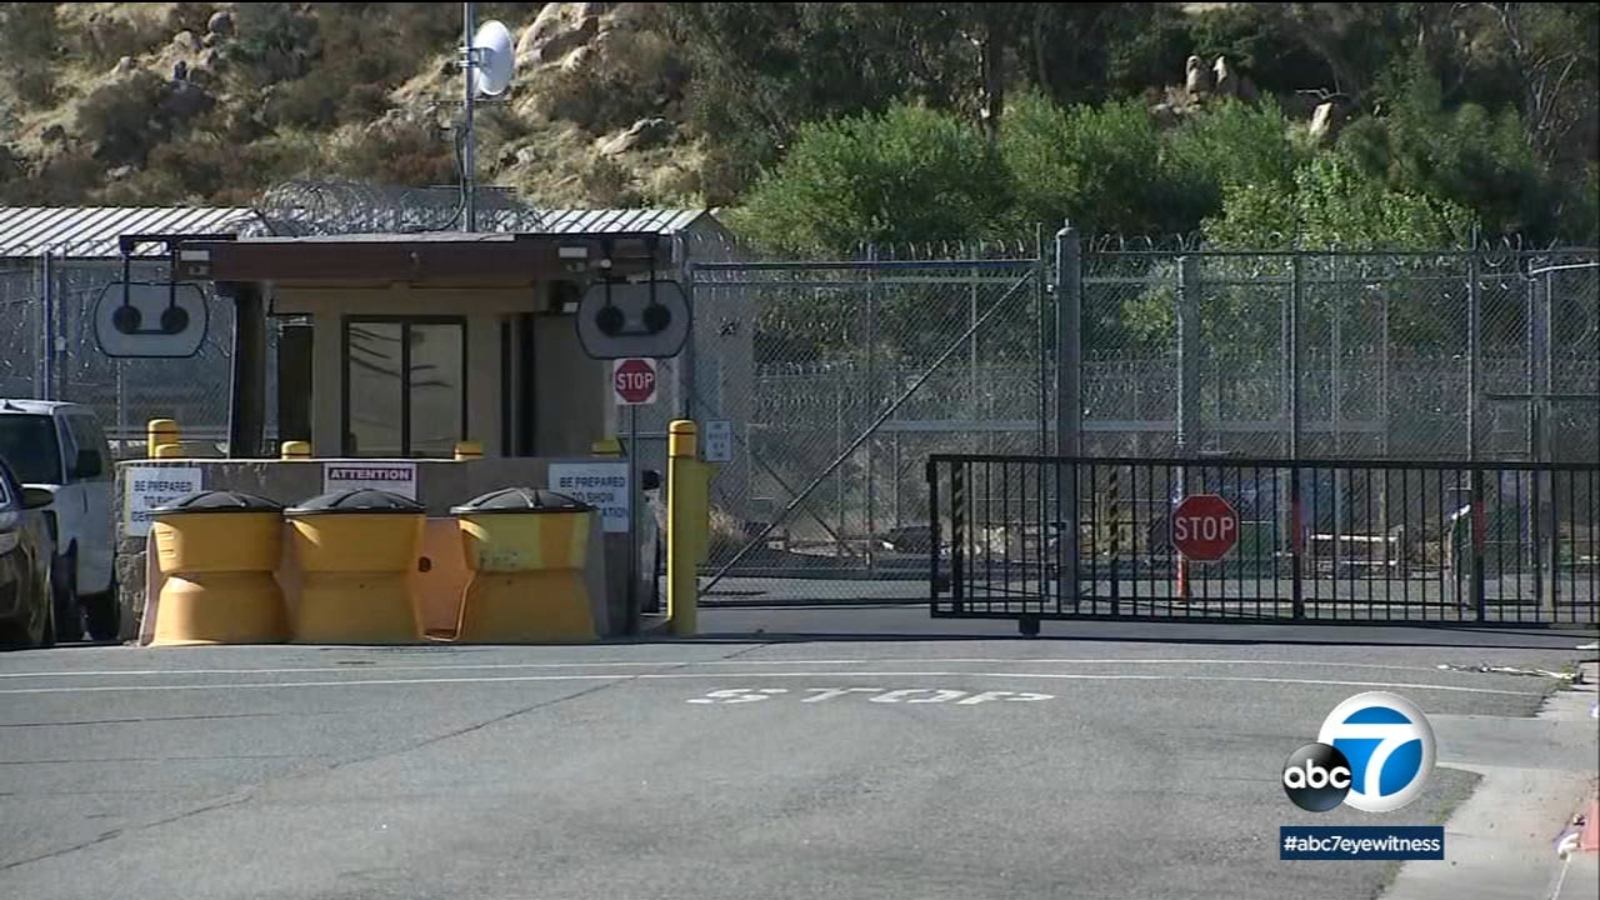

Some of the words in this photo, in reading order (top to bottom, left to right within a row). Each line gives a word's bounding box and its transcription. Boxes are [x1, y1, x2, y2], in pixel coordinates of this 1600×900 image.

[617, 373, 654, 390] STOP
[330, 468, 410, 480] ATTENTION
[134, 480, 146, 492] BE
[147, 480, 193, 492] PREPARED
[561, 476, 573, 488] BE
[575, 476, 626, 488] PREPARED
[1174, 516, 1235, 541] STOP
[686, 687, 1056, 705] STOP
